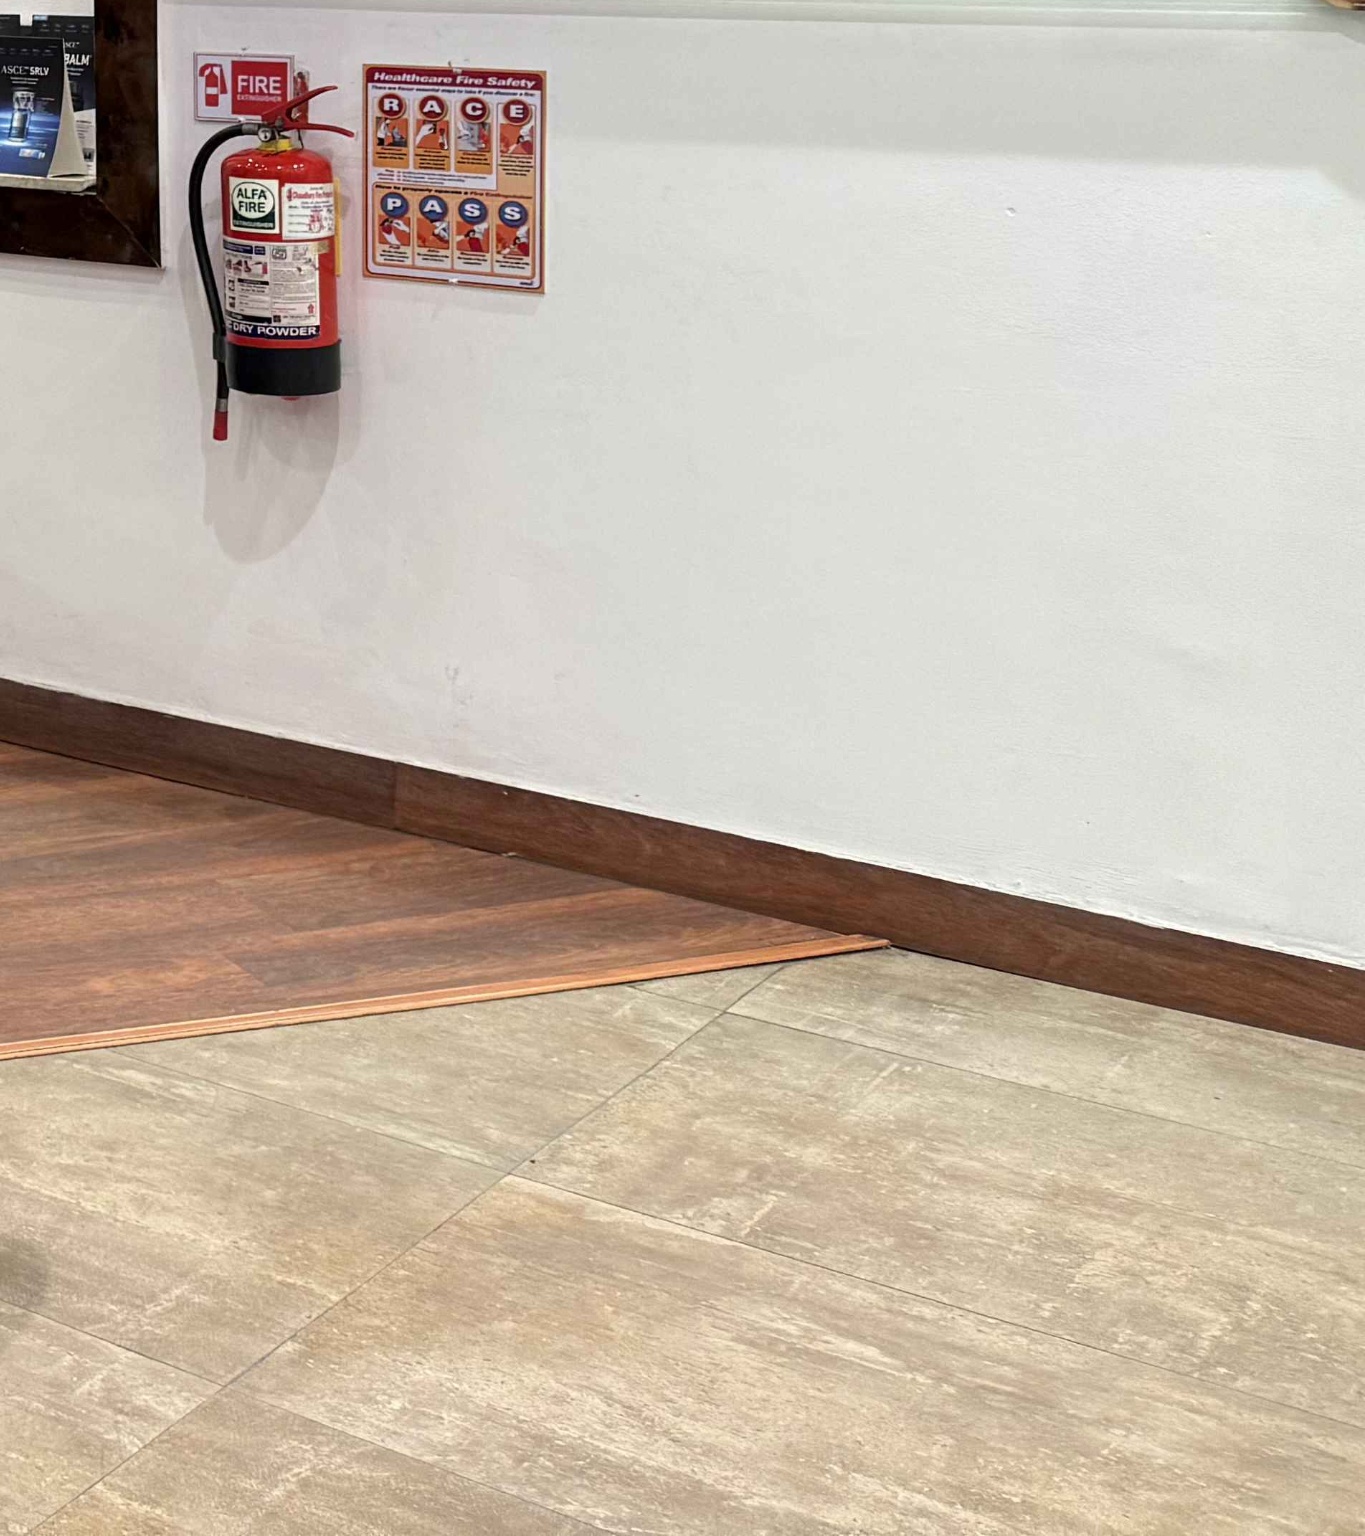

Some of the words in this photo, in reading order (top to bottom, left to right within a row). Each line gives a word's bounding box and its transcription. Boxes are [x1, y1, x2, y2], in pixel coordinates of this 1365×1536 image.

[237, 75, 282, 94] FIRE
[374, 72, 452, 84] Healthcare
[456, 74, 483, 85] Fire
[486, 76, 537, 89] Safety
[383, 98, 399, 111] R
[422, 100, 442, 113] A
[465, 102, 483, 115] C
[509, 104, 524, 117] E
[236, 187, 268, 201] ALFA
[238, 200, 266, 214] FIRE
[386, 198, 402, 211] P
[423, 200, 443, 213] A
[463, 203, 481, 217] S
[504, 206, 522, 220] S
[233, 321, 254, 335] DRY
[257, 325, 317, 337] POWDER
